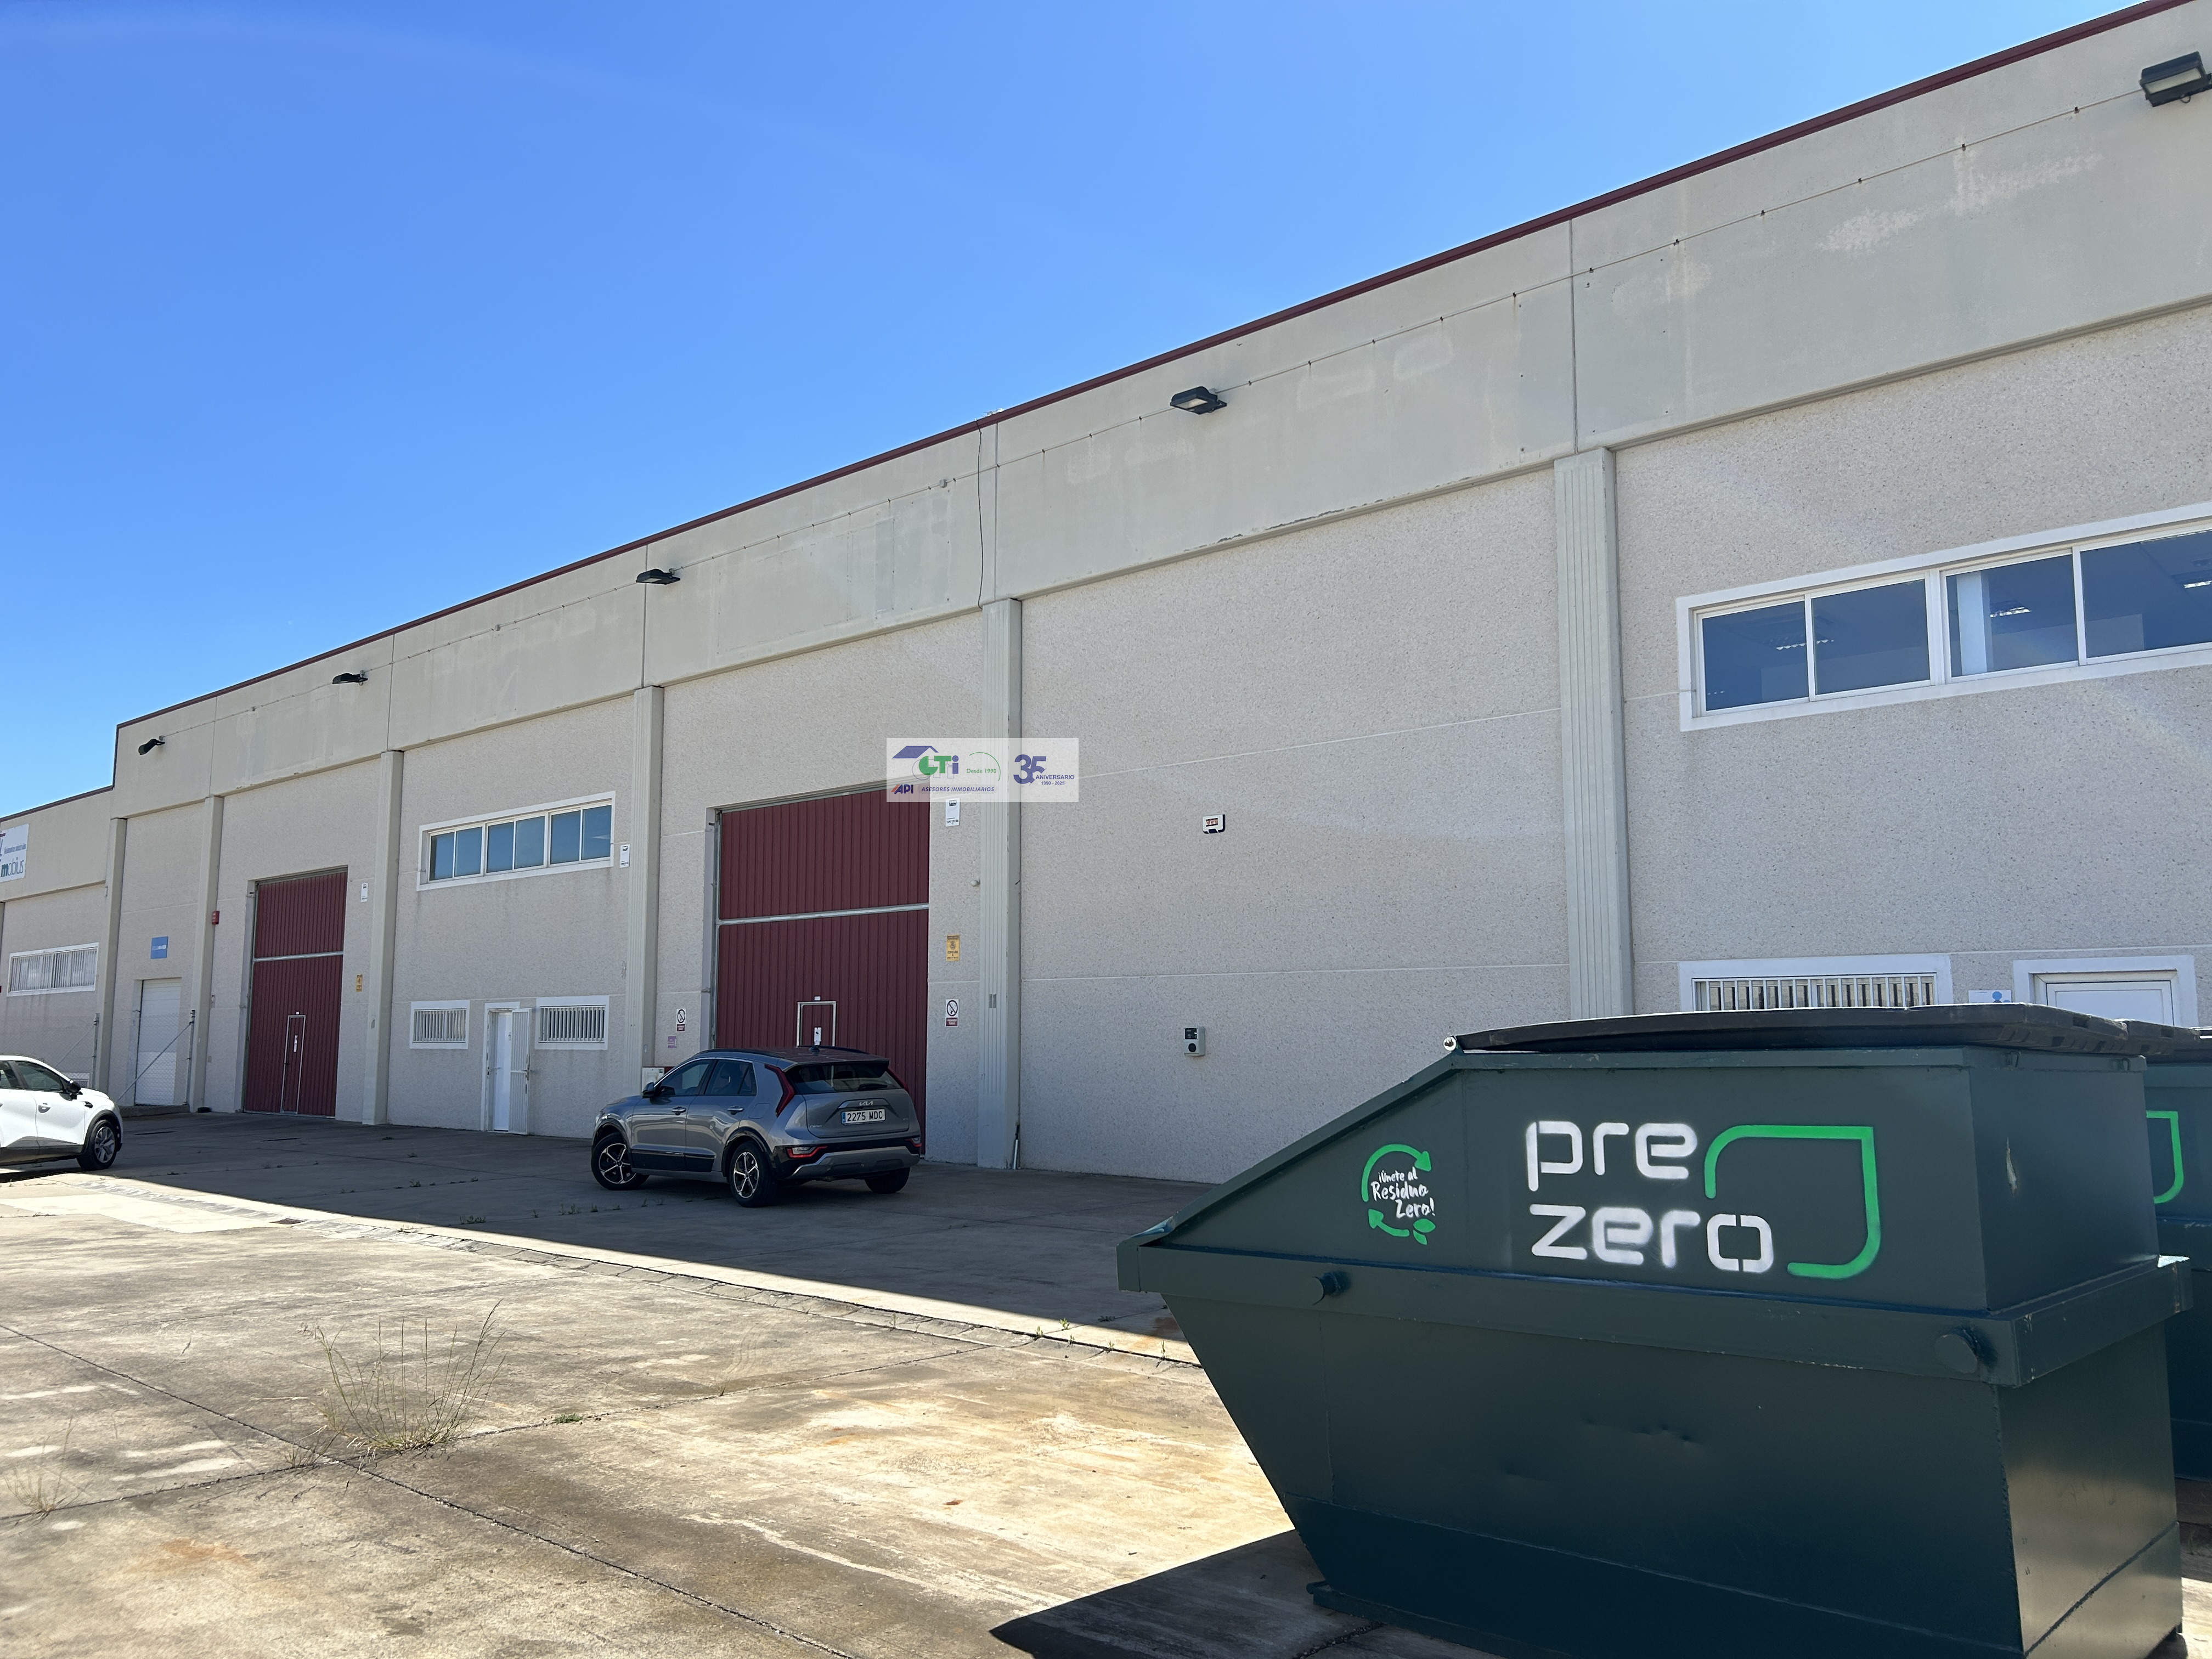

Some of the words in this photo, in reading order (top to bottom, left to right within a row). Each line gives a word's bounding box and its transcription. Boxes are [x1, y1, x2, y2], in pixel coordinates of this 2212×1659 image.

[847, 1111, 866, 1122] 2275
[869, 1110, 883, 1120] MDC
[1525, 1120, 1698, 1192] pre
[1407, 1166, 1418, 1180] al
[1370, 1180, 1429, 1201] Residuo
[1395, 1197, 1436, 1218] Zero!
[1529, 1203, 1775, 1274] zero
